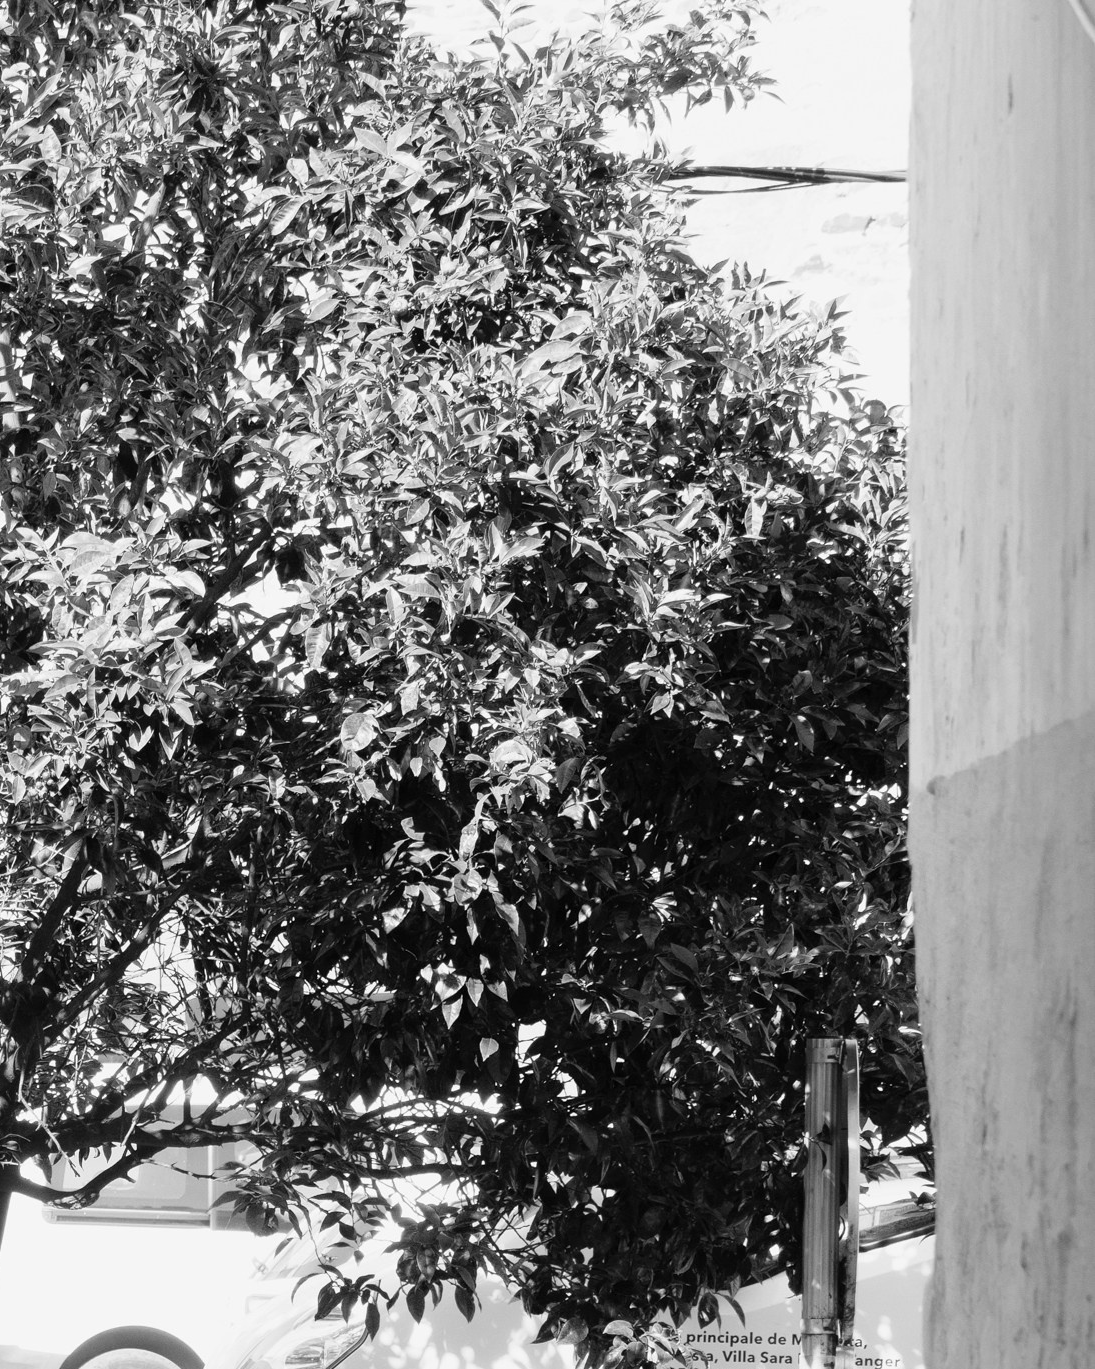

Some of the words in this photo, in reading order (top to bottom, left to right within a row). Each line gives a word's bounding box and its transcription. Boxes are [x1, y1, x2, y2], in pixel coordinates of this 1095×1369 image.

[686, 1331, 763, 1347] principale
[767, 1332, 787, 1345] de
[722, 1350, 755, 1363] Villa
[760, 1351, 793, 1364] Sara
[854, 1353, 900, 1369] anger
